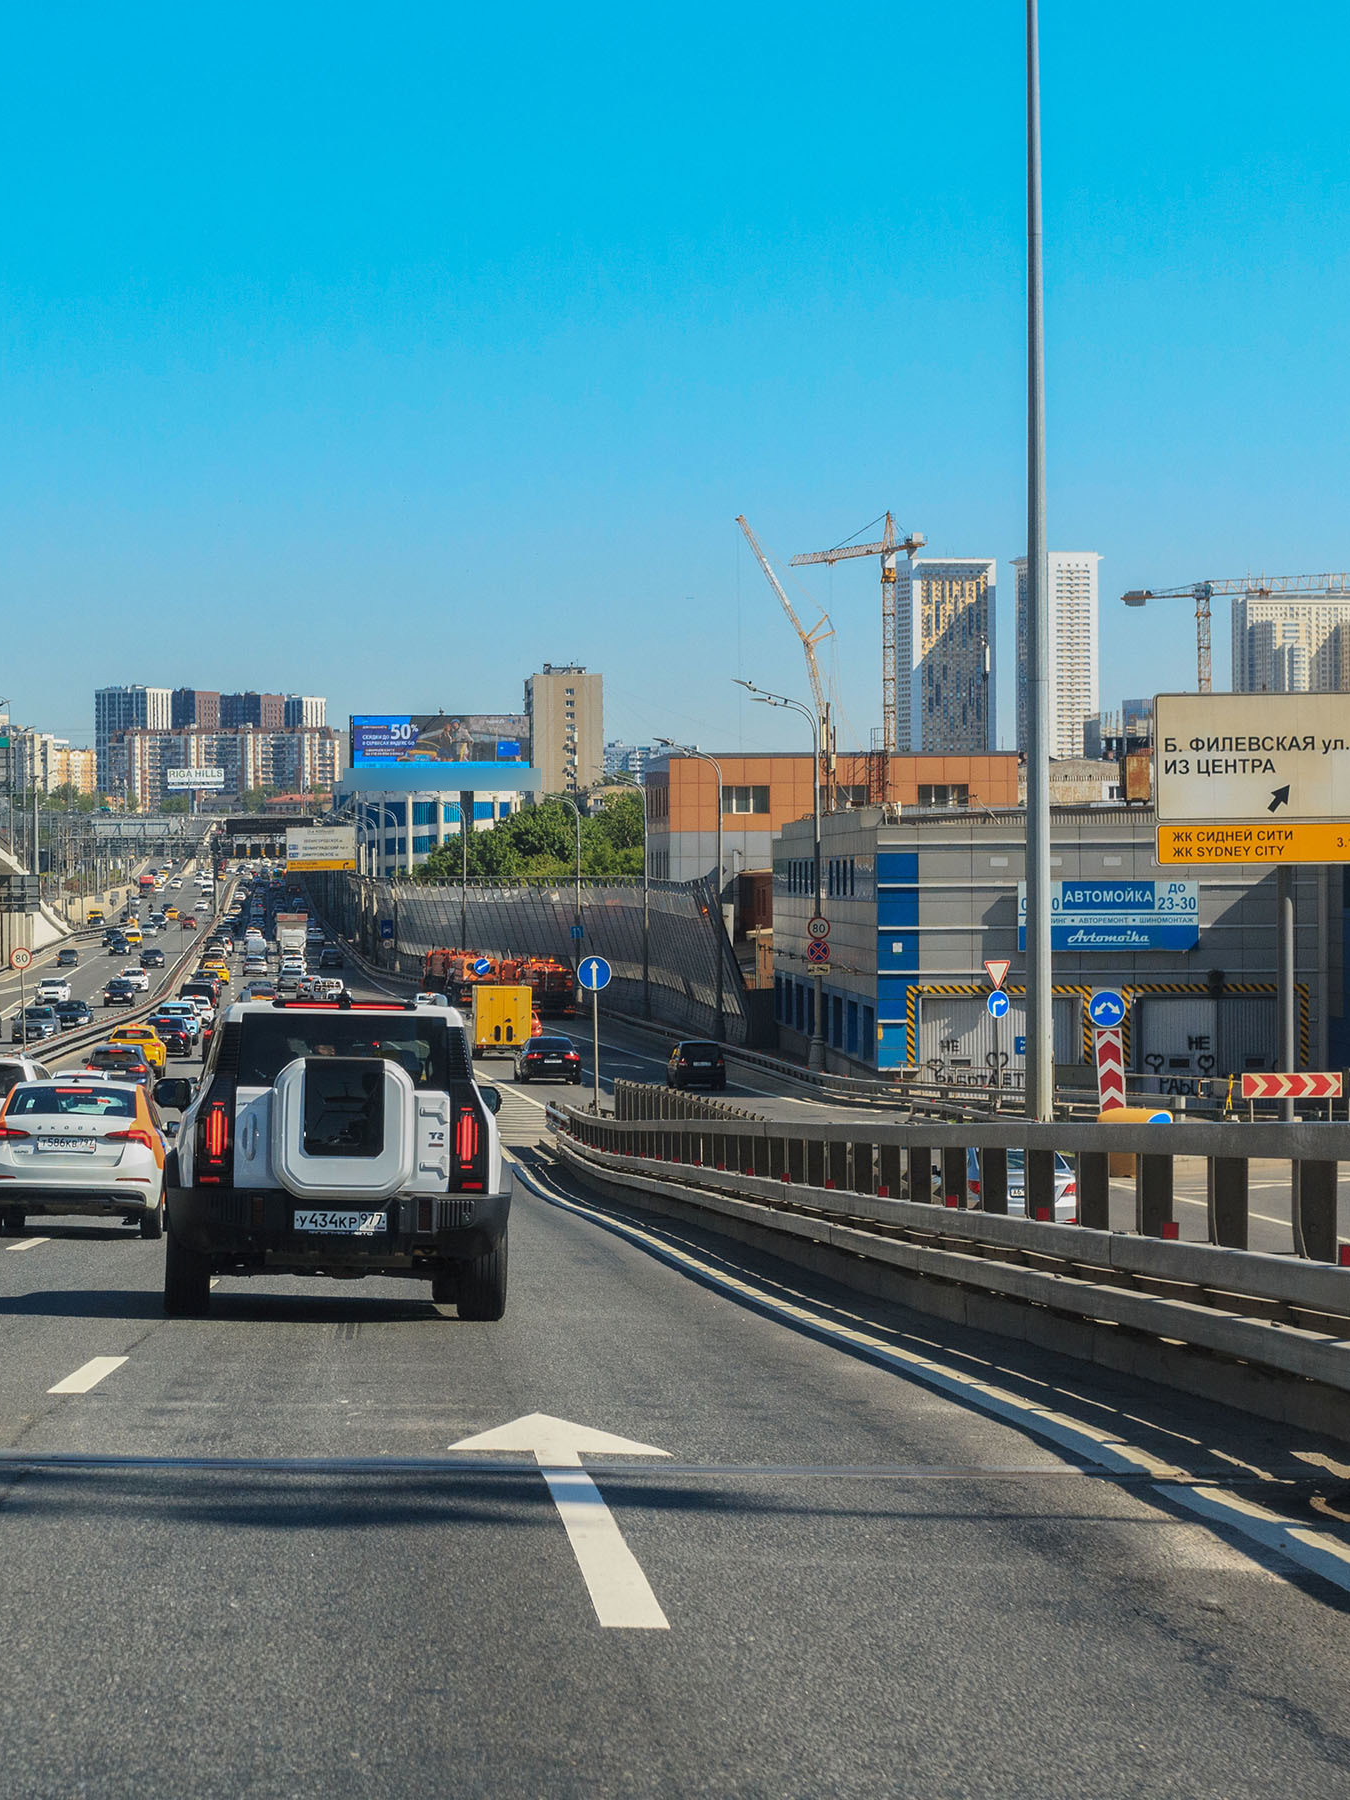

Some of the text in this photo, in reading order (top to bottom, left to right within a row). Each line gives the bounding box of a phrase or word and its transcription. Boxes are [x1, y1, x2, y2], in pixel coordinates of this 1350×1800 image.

[391, 724, 419, 740] 50%
[1164, 736, 1350, 755] Б. ФИЛЕВСКАЯ ул.
[169, 769, 223, 778] RIGA HILLS
[1164, 758, 1276, 777] ИЗ ЦЕНТРА
[1172, 829, 1293, 843] ЖК СИДНЕЙ СИТИ
[1337, 837, 1350, 848] 3.
[1172, 845, 1285, 857] ЖК SYDNEY CITY
[1064, 888, 1153, 903] АВТОМОЙКА
[1168, 884, 1186, 895] ДО
[1157, 897, 1196, 910] 23-30
[1139, 916, 1194, 924] ШИНОМОНТАЖ
[812, 923, 826, 933] 80
[15, 953, 28, 963] 80
[1187, 1035, 1210, 1051] НЕ
[298, 1212, 383, 1229] У434КР 977
